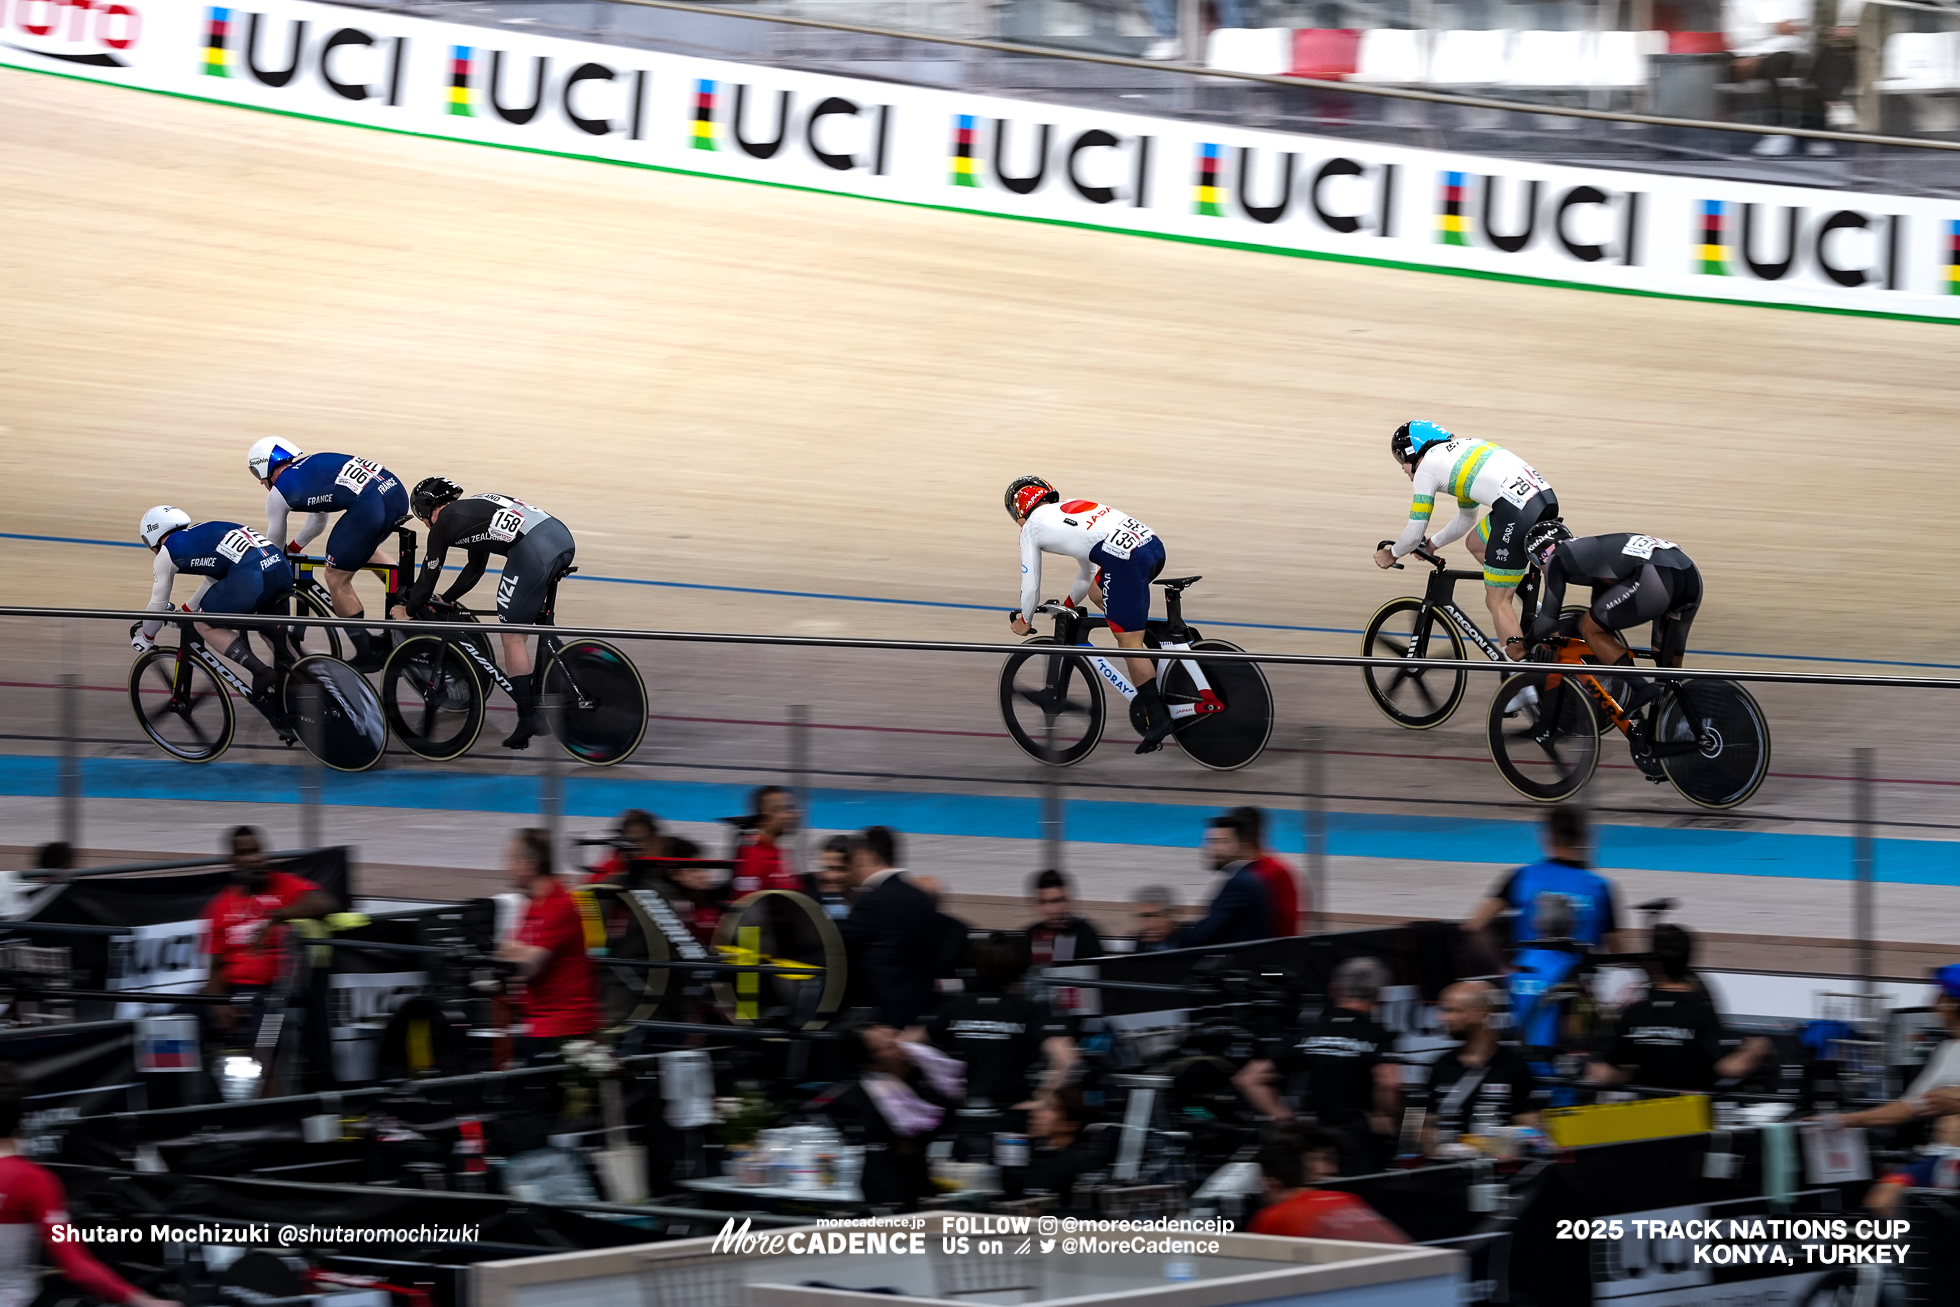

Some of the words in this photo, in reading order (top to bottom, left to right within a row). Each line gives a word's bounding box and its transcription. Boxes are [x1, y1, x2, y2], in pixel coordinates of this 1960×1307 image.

[244, 13, 406, 106] UCI
[484, 50, 649, 140] UCI
[729, 83, 896, 175] UCI
[988, 117, 1157, 208] UCI
[1234, 146, 1402, 237] UCI
[1479, 175, 1648, 266] UCI
[1736, 203, 1908, 290] UCI
[343, 463, 369, 485] 106
[377, 477, 398, 495] FRANCE
[1509, 476, 1531, 496] 79
[307, 493, 333, 506] FRANCE
[1025, 489, 1044, 509] JAPAN
[494, 511, 521, 533] 158
[1086, 506, 1113, 530] JAPA
[225, 531, 250, 553] 110
[455, 536, 470, 546] NEW
[1110, 529, 1137, 551] 135
[190, 557, 217, 568] FRANCE
[260, 553, 282, 571] FRANCE
[496, 575, 519, 610] NZL
[1606, 581, 1640, 610] MALAYSIA
[1443, 604, 1487, 649] ARGON
[1484, 645, 1499, 661] 18
[189, 641, 253, 700] LOOK
[459, 640, 514, 692] AVANTI
[1175, 707, 1193, 715] JAPAN
